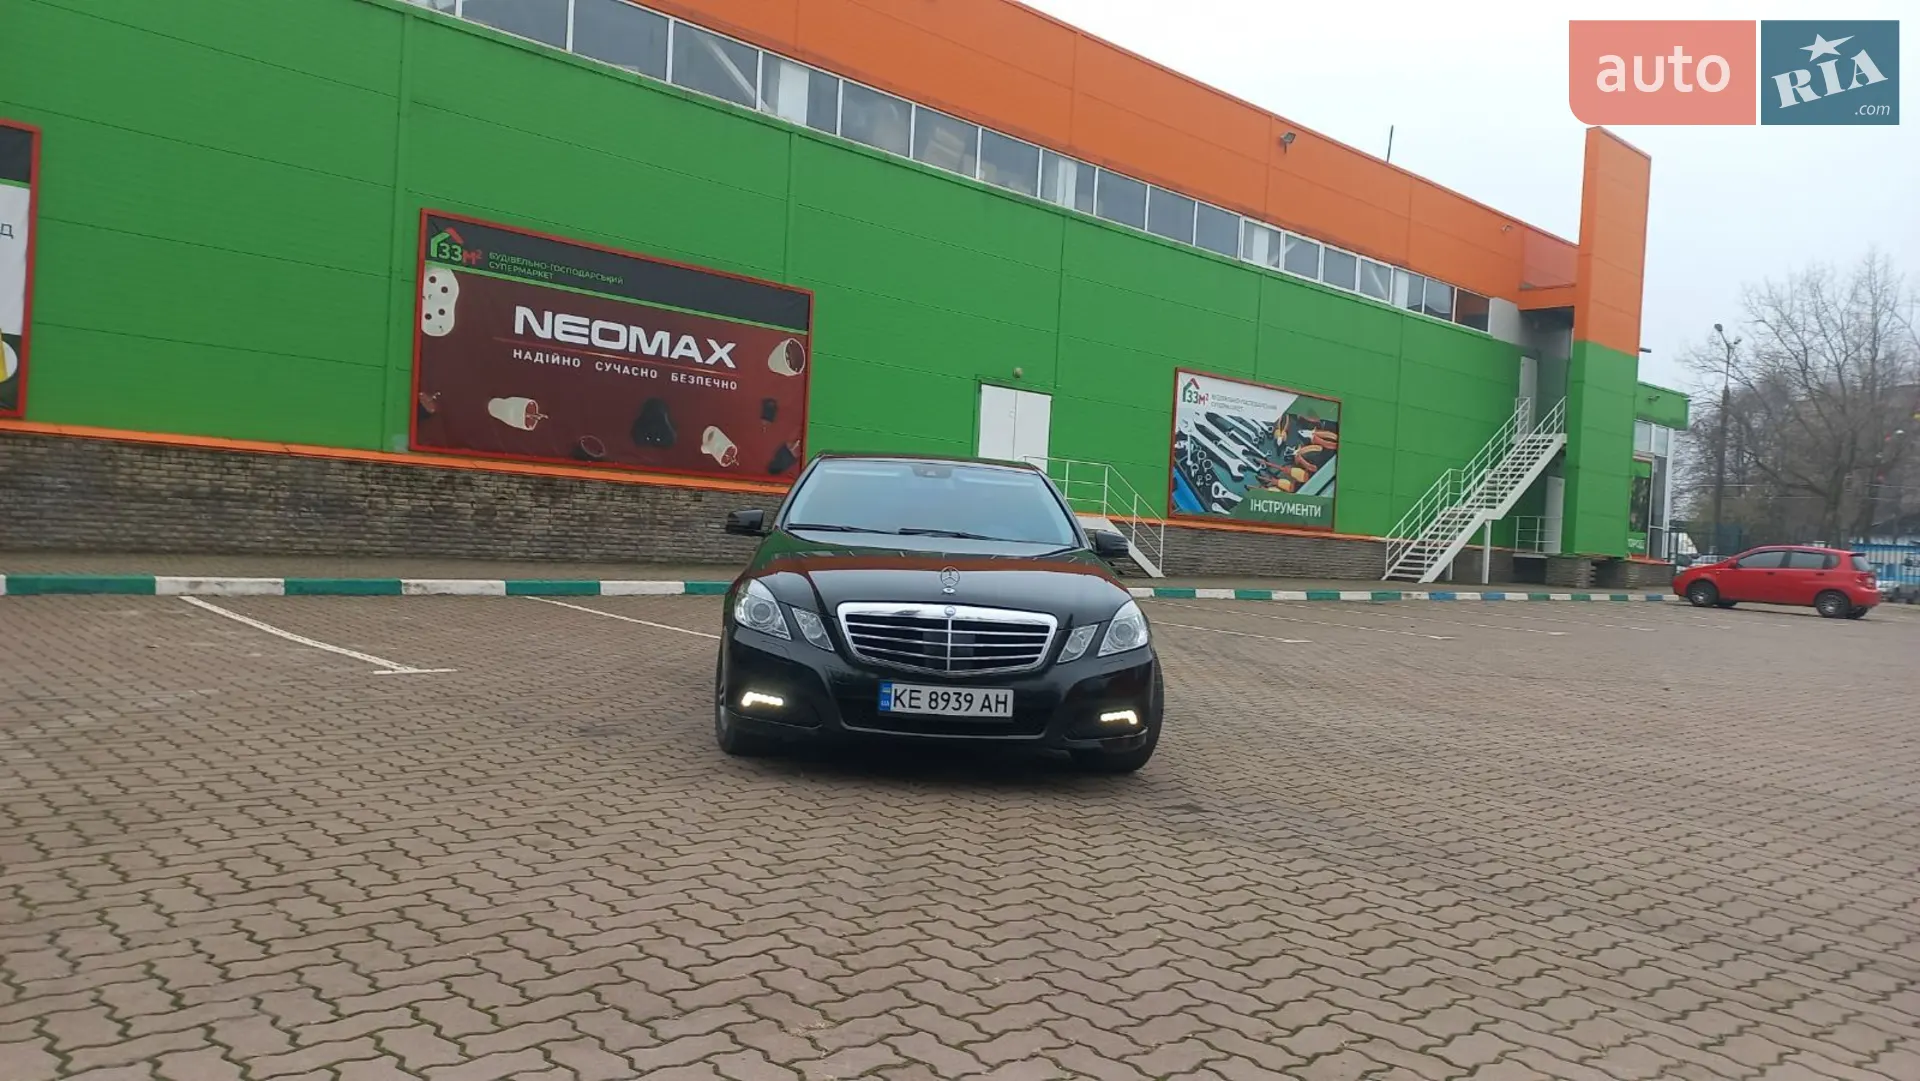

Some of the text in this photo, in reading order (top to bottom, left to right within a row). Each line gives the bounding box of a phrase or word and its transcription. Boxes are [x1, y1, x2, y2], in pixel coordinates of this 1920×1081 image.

[489, 261, 554, 280] СУПЕРМАРКЕТ
[514, 305, 737, 368] NEOMAX
[512, 348, 738, 391] НАДІЙНО СУЧАСНО БЕЗПЕЧНО
[1250, 498, 1322, 518] ІНСТРУМЕНТИ
[893, 688, 1009, 714] KE 8939 AH
